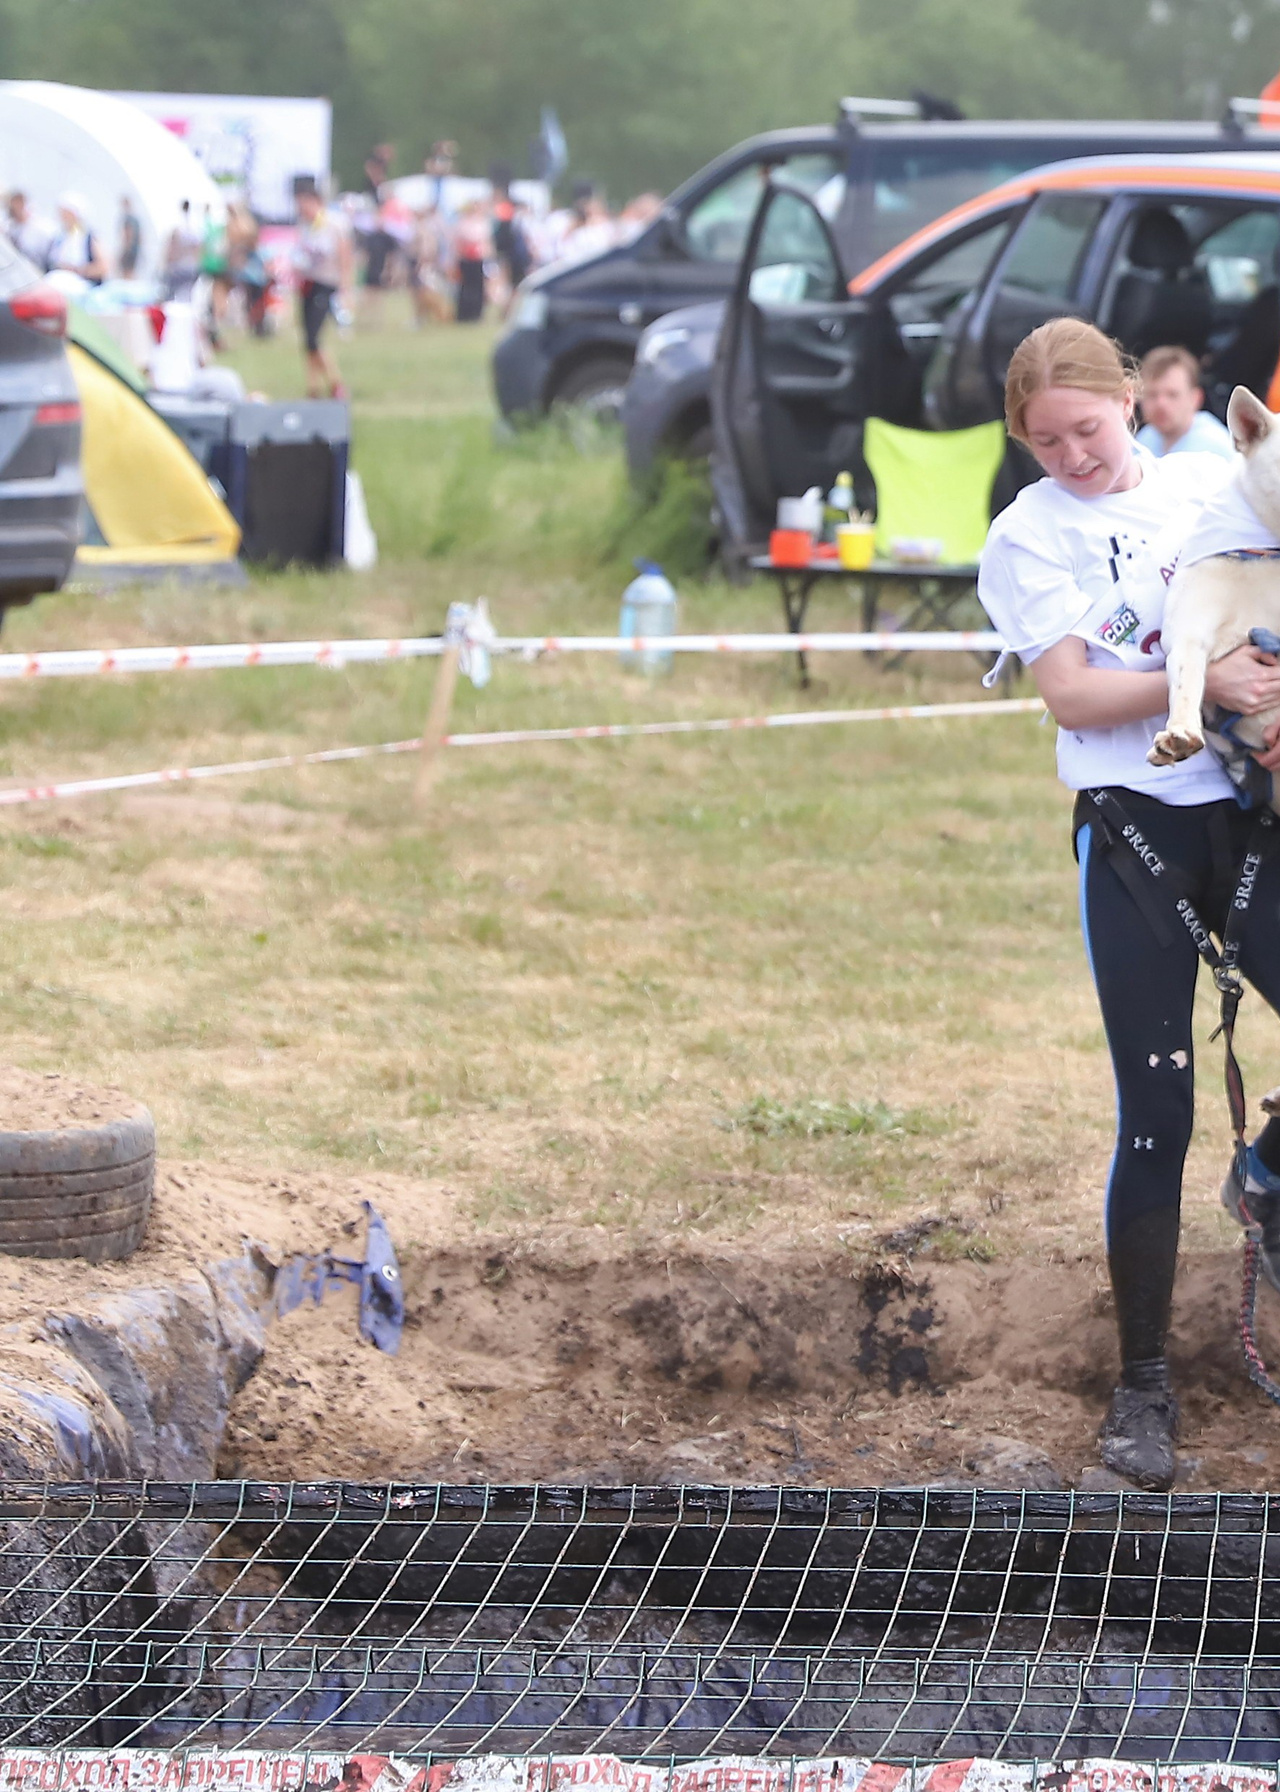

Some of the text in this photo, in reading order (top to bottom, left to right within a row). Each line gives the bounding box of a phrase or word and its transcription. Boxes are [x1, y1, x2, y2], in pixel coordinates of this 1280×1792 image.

[1102, 608, 1136, 644] CDR
[1128, 832, 1164, 877] RACE
[1236, 852, 1260, 899] RACE
[1181, 907, 1211, 952] RACE
